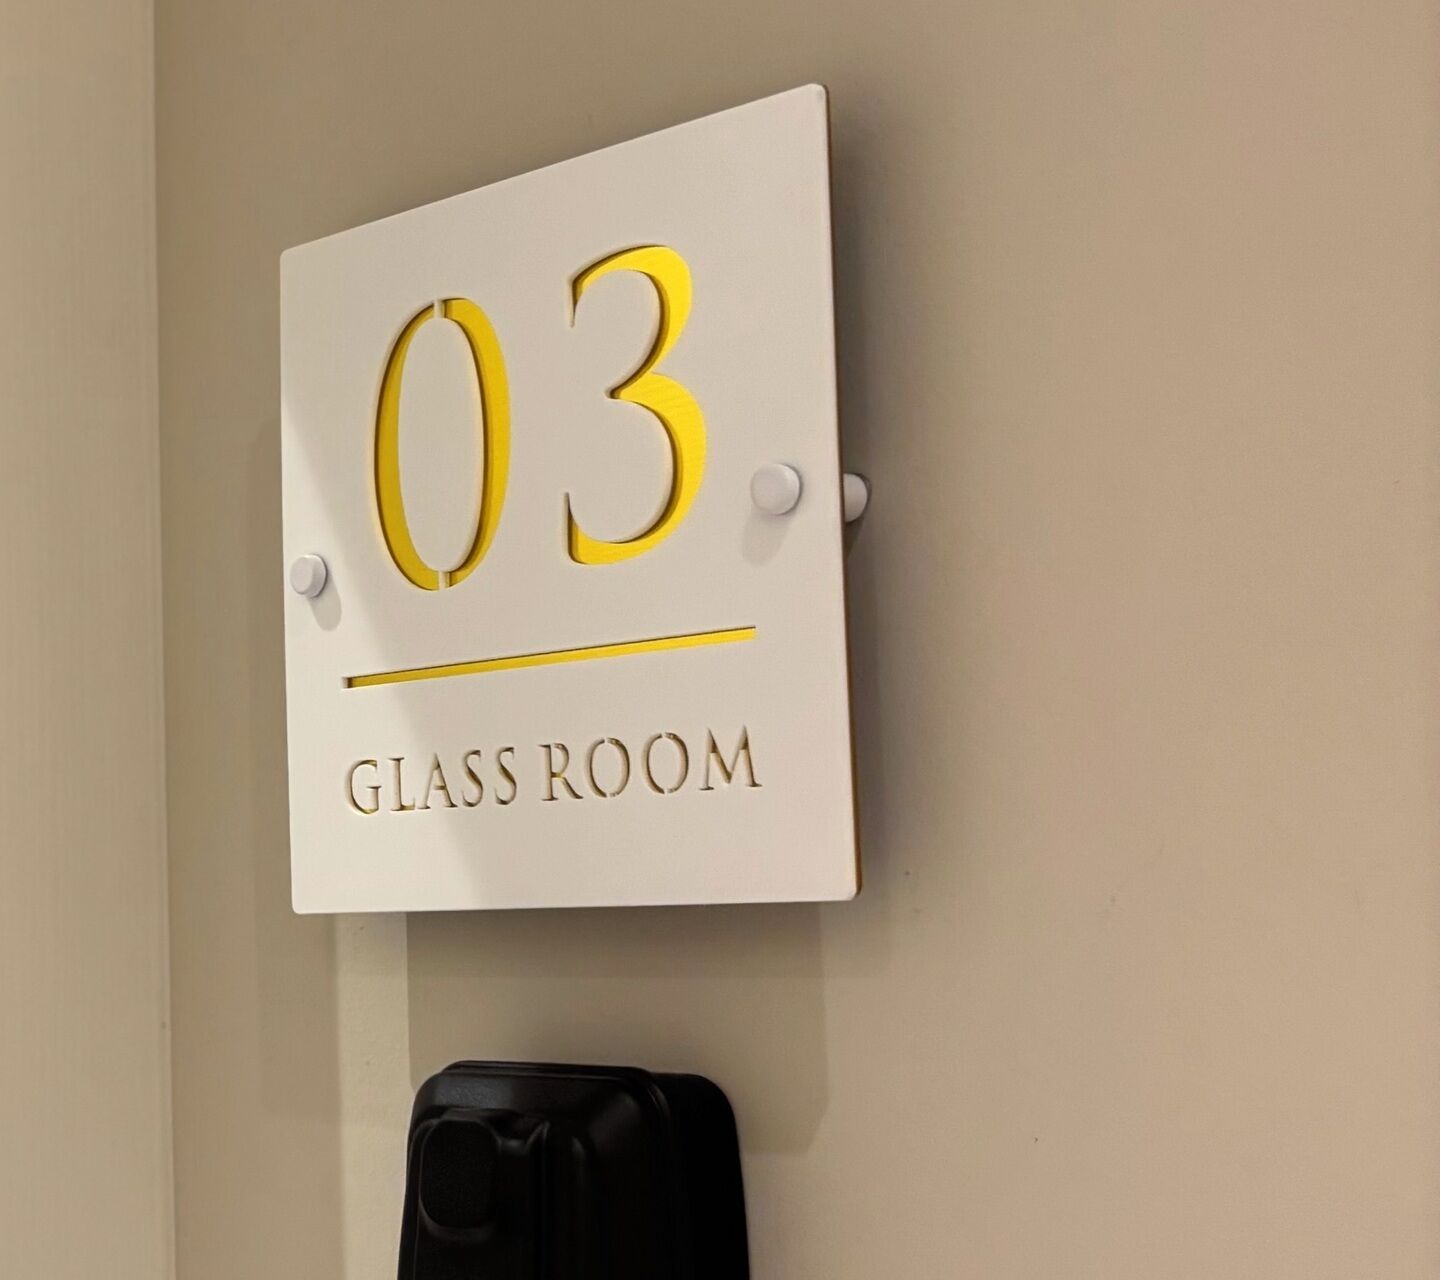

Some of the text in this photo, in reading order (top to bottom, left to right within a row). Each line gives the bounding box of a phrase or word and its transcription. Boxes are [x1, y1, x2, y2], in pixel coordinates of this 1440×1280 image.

[373, 243, 707, 592] 03
[344, 724, 762, 815] GLASS ROOM
